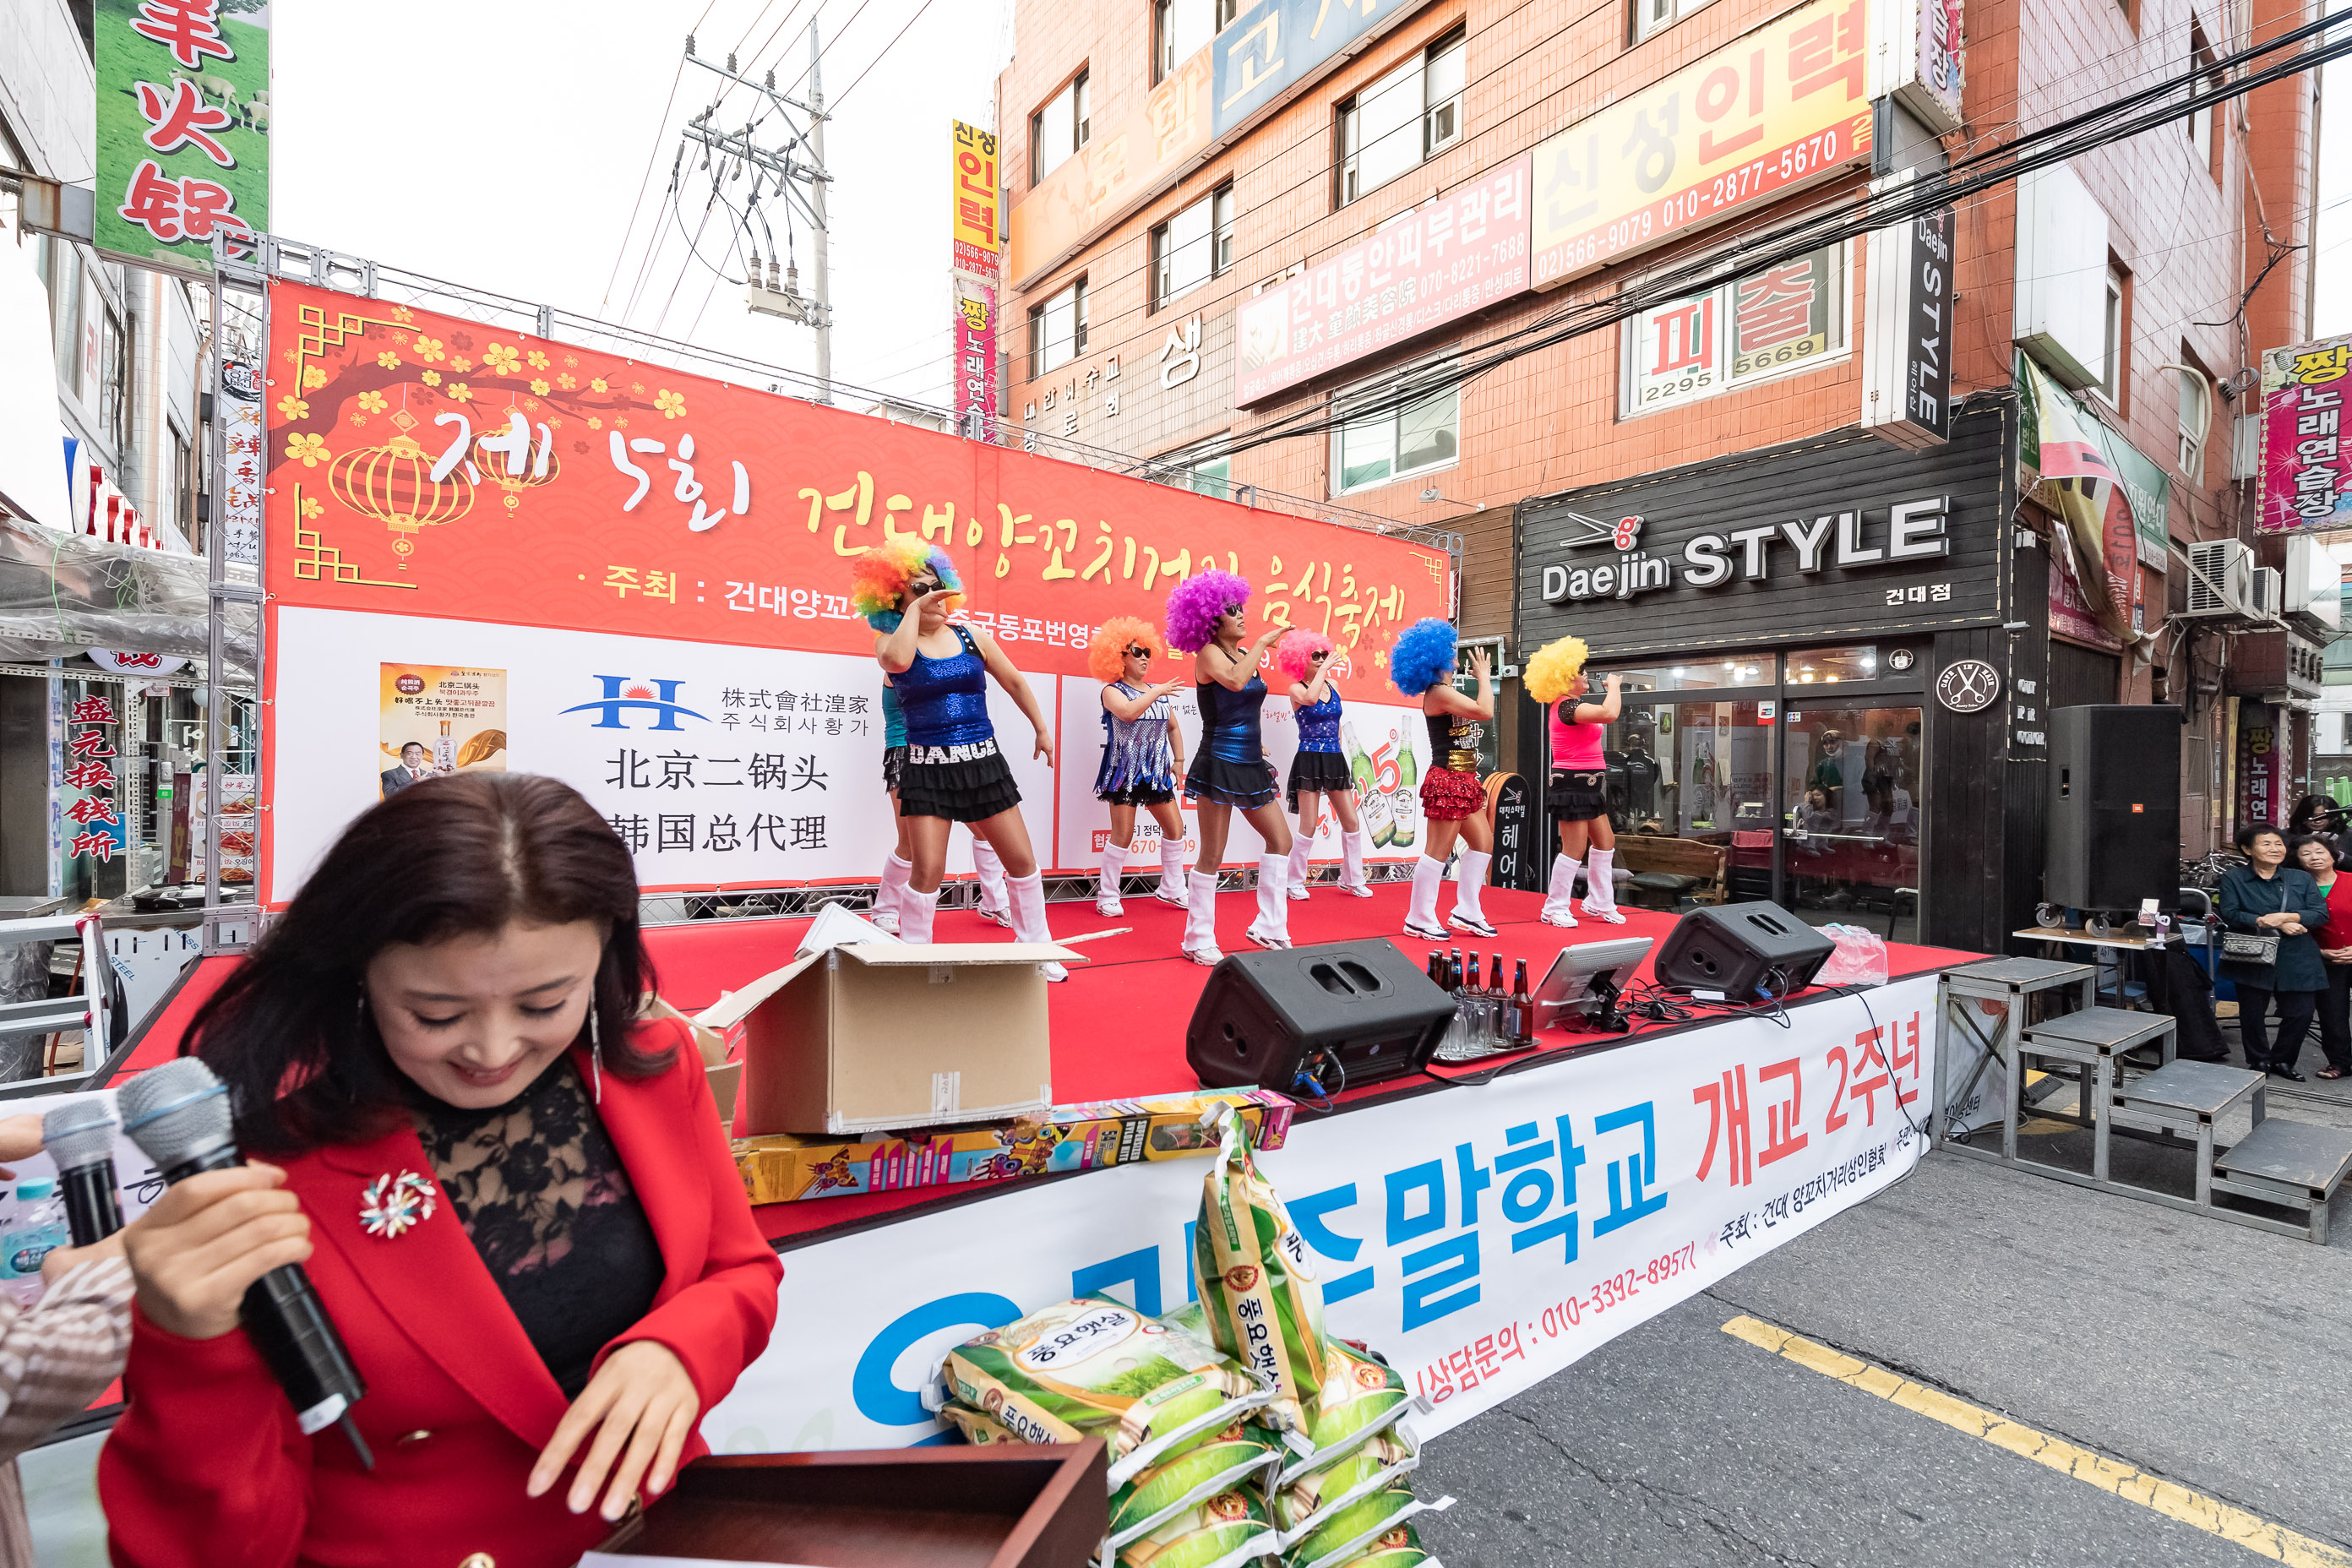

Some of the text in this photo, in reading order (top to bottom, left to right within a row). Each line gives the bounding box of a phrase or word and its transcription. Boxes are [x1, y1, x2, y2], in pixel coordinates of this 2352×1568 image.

[956, 122, 996, 155] 신성
[1544, 3, 1867, 232] 신성인력
[959, 151, 994, 245] 인력
[1538, 130, 1837, 280] 02)566-9079 010-2877-5670
[955, 241, 999, 266] 02)566-9079
[956, 258, 999, 280] 010-2877-5670
[1420, 231, 1525, 299] 070-8221-7688
[1919, 215, 1947, 426] Daejin STYLE
[1646, 340, 1815, 402] 2295 5669
[429, 411, 751, 533] 제 5회
[2291, 386, 2342, 519] 노래연습장
[1542, 497, 1947, 602] Daejin STYLE
[602, 564, 677, 605] 주최
[1262, 555, 1405, 650] 음식축제
[1885, 583, 1952, 607] 건대점
[438, 681, 481, 690] 北京二锅头
[720, 711, 870, 737] 주식회사황가
[605, 747, 830, 792] 北京二锅头
[909, 737, 997, 765] DANCE
[64, 695, 119, 863] 盛元换钱所
[605, 811, 830, 855] 韩国总代理
[1499, 804, 1526, 819] 대진스타일
[110, 956, 137, 983] STEEL
[1692, 1063, 1809, 1188] 개교
[1825, 1010, 1919, 1135] 2주년
[1121, 1121, 1136, 1145] NYLON
[1130, 1119, 1147, 1162] SUPERSIZED
[1719, 1213, 1750, 1249] 주최
[1761, 1193, 1788, 1228] 건대
[1792, 1141, 1887, 1214] 양꼬치거리상인협회
[1027, 1311, 1130, 1364] 풍요햇살
